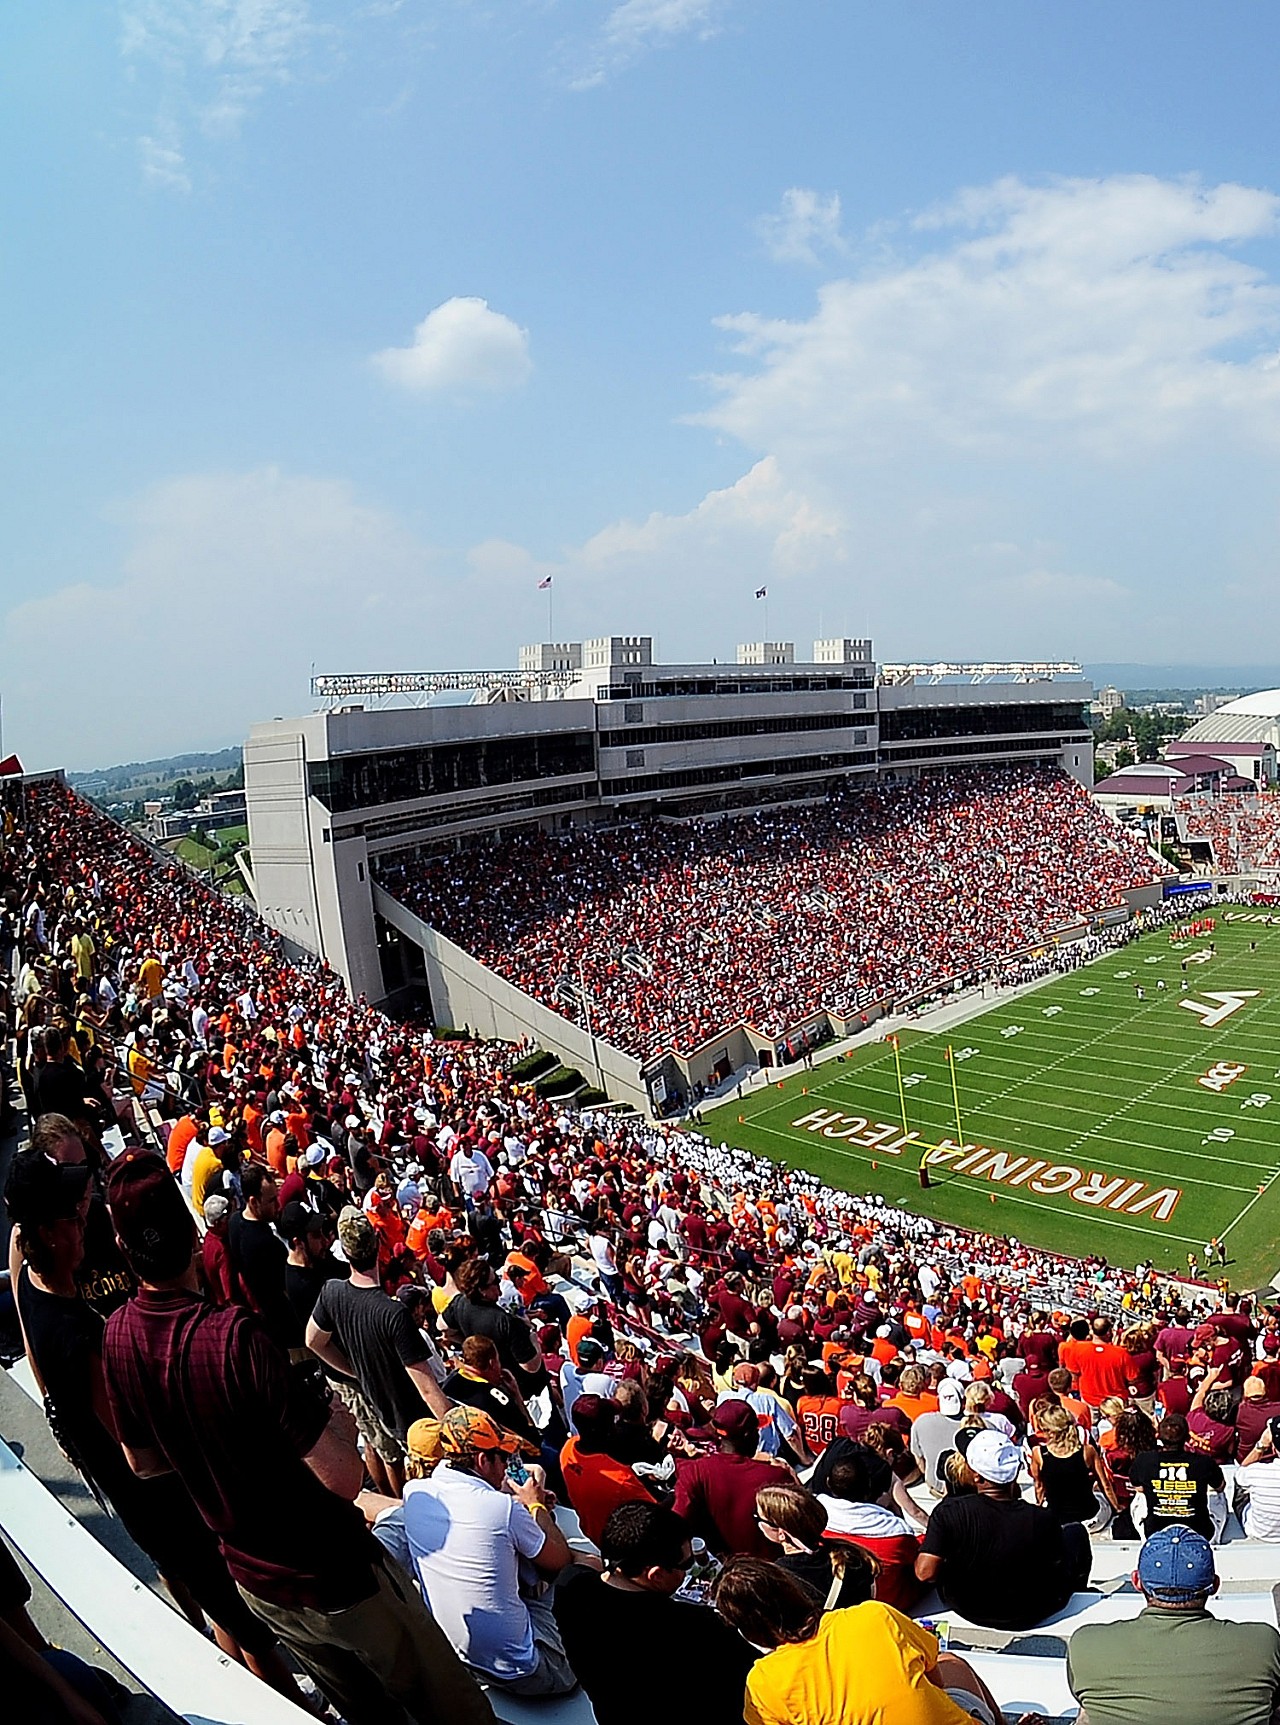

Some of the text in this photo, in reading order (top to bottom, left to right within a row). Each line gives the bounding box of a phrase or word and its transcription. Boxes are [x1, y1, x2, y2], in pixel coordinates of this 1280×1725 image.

[1198, 1062, 1247, 1092] ACC
[1207, 1127, 1235, 1142] 10
[791, 1107, 1182, 1222] VIRGINIA TECH
[803, 1412, 839, 1443] 28
